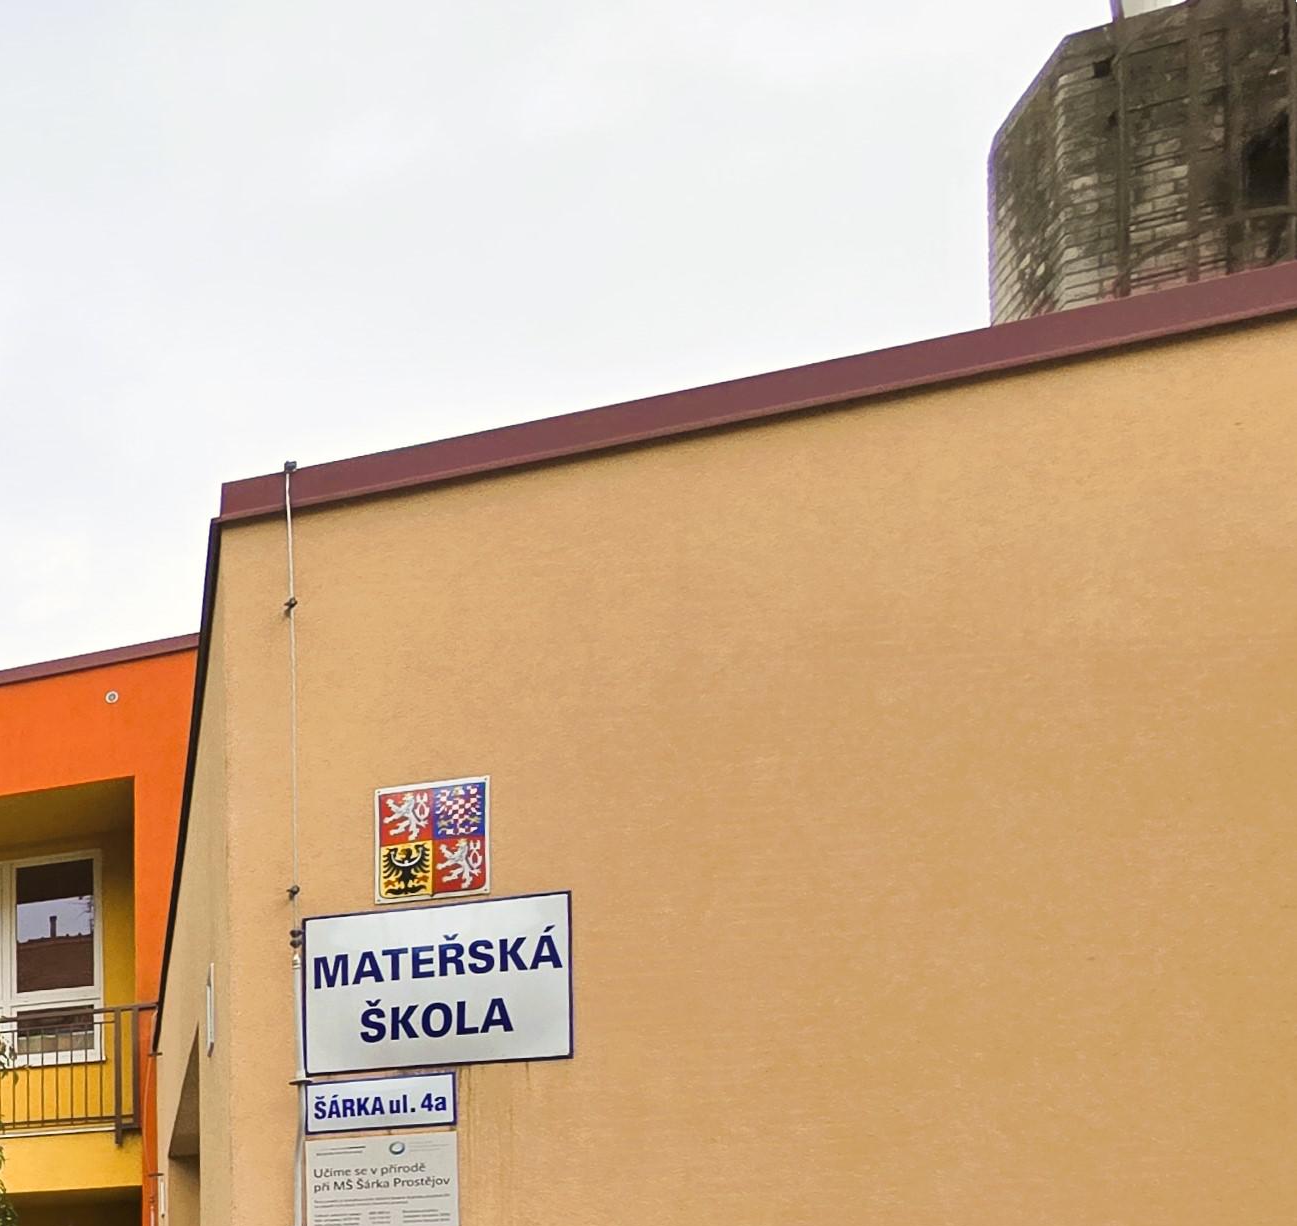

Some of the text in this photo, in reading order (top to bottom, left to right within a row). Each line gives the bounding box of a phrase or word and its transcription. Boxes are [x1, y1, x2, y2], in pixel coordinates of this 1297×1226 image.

[313, 925, 563, 990] MATEŘSKÁ
[360, 998, 514, 1043] ŠKOLA
[314, 1092, 447, 1119] ŠÁRKA ul. 4a
[313, 1176, 450, 1194] při MŠ Šárka Prostějov
[354, 1167, 368, 1176] se
[370, 1167, 378, 1175] v
